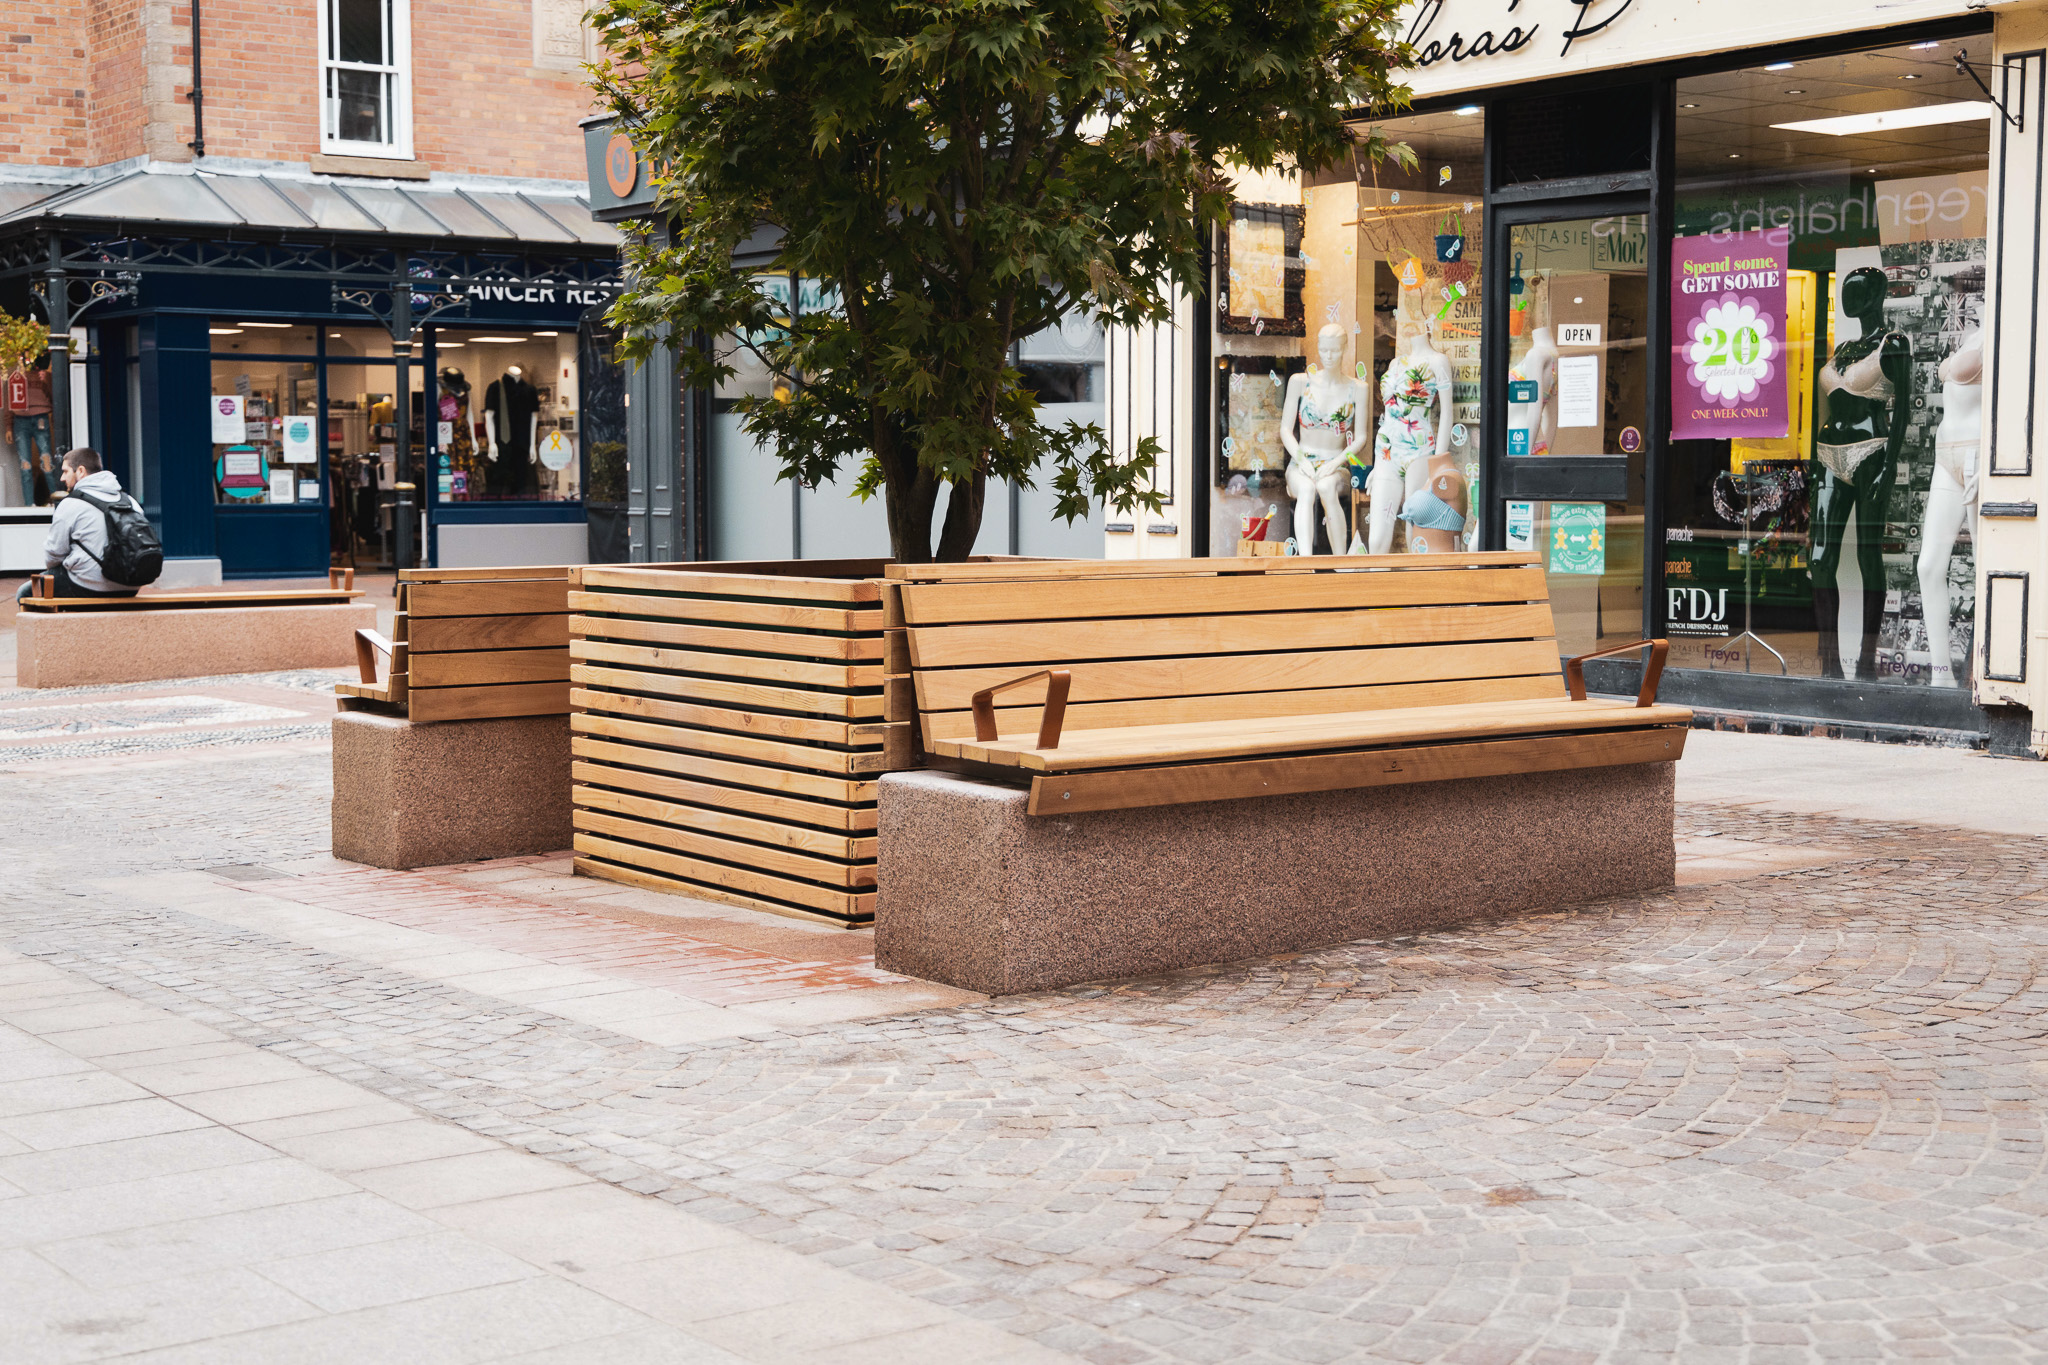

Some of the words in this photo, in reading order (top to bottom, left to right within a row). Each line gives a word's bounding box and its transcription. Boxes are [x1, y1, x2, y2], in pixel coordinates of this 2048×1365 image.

[1606, 231, 1646, 264] Moi?
[1683, 256, 1730, 278] Spend
[1733, 257, 1778, 271] some,
[446, 274, 555, 303] CANCER
[1681, 275, 1721, 294] GET
[1723, 270, 1780, 291] SOME
[1565, 328, 1592, 341] OPEN
[1691, 409, 1711, 419] ONE
[1713, 408, 1739, 419] WEEK
[1740, 407, 1768, 418] ONLY!
[1555, 510, 1571, 526] Leave
[1571, 506, 1586, 515] extra
[1666, 525, 1694, 544] panache
[1665, 556, 1692, 577] panache
[1666, 587, 1729, 622] FDJ
[1704, 644, 1740, 665] Freya
[1879, 655, 1921, 678] Freya
